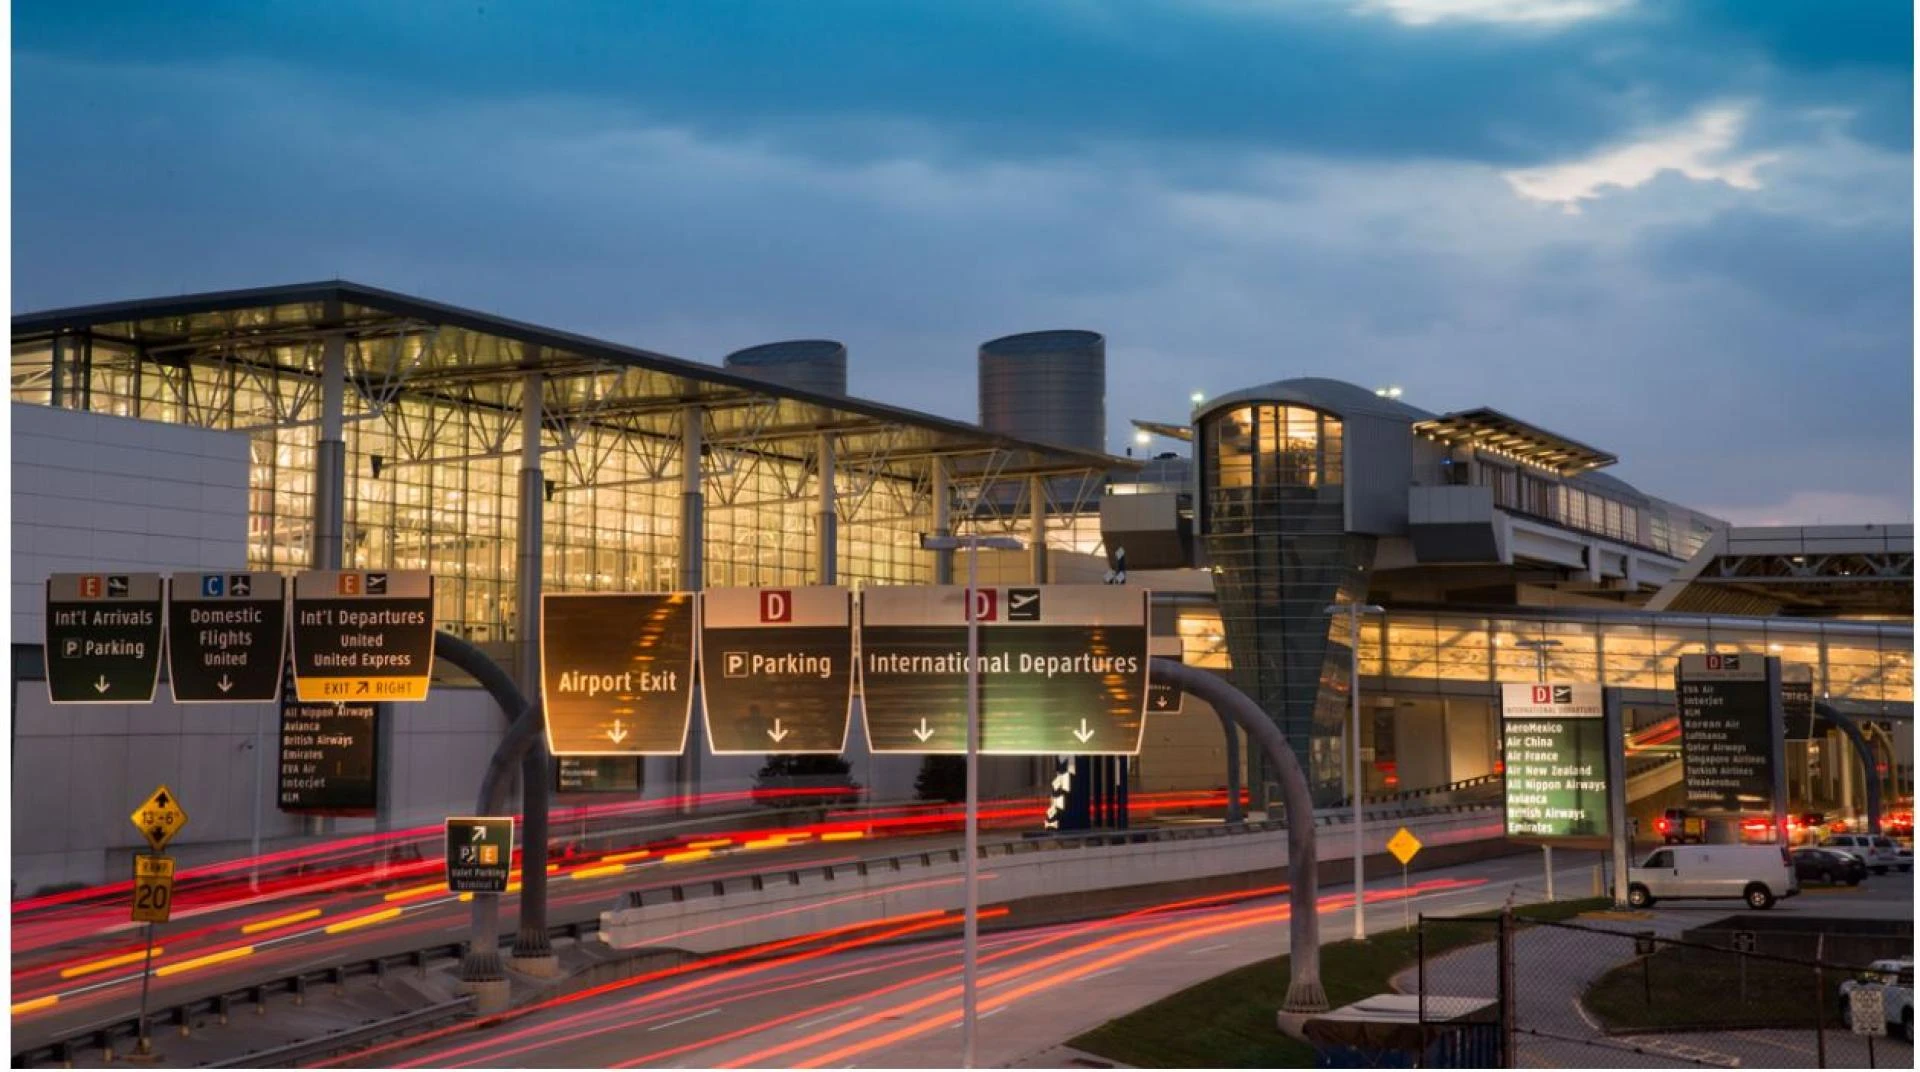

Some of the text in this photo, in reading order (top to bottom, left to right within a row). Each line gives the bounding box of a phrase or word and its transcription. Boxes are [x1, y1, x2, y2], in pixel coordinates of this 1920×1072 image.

[86, 578, 96, 594] E
[208, 577, 219, 594] C
[344, 575, 355, 593] E
[767, 593, 784, 620] D
[976, 592, 990, 618] D
[55, 609, 153, 625] Int'l Arrivals
[190, 608, 262, 623] Domestic
[300, 610, 425, 628] Int'l Departures
[199, 630, 253, 650] Flights
[341, 633, 383, 647] United
[66, 639, 145, 659] P Parking
[205, 652, 248, 666] United
[314, 653, 411, 669] United Express
[727, 653, 832, 678] P Parking
[1019, 652, 1138, 678] Departures
[1710, 656, 1718, 668] D
[324, 682, 412, 694] EXIT RIGHT
[559, 671, 677, 696] Airport Exit
[1536, 688, 1547, 702] D
[302, 706, 334, 719] Nippon
[338, 706, 374, 719] Airways
[284, 721, 320, 731] Avianca
[1505, 723, 1563, 733] AeroMexico
[1725, 720, 1740, 728] Air
[284, 735, 354, 748] British Airways
[1506, 737, 1553, 747] Air China
[283, 750, 323, 760] Emirates
[1507, 751, 1559, 761] Air France
[303, 764, 316, 774] Air
[1507, 765, 1592, 776] Air New Zealand
[283, 777, 326, 789] Interjet
[1508, 779, 1606, 791] All Nippon Airways
[1508, 794, 1548, 804] Avianca
[1508, 807, 1585, 821] British Airways
[1508, 822, 1553, 833] Emirates
[137, 884, 167, 910] 20
